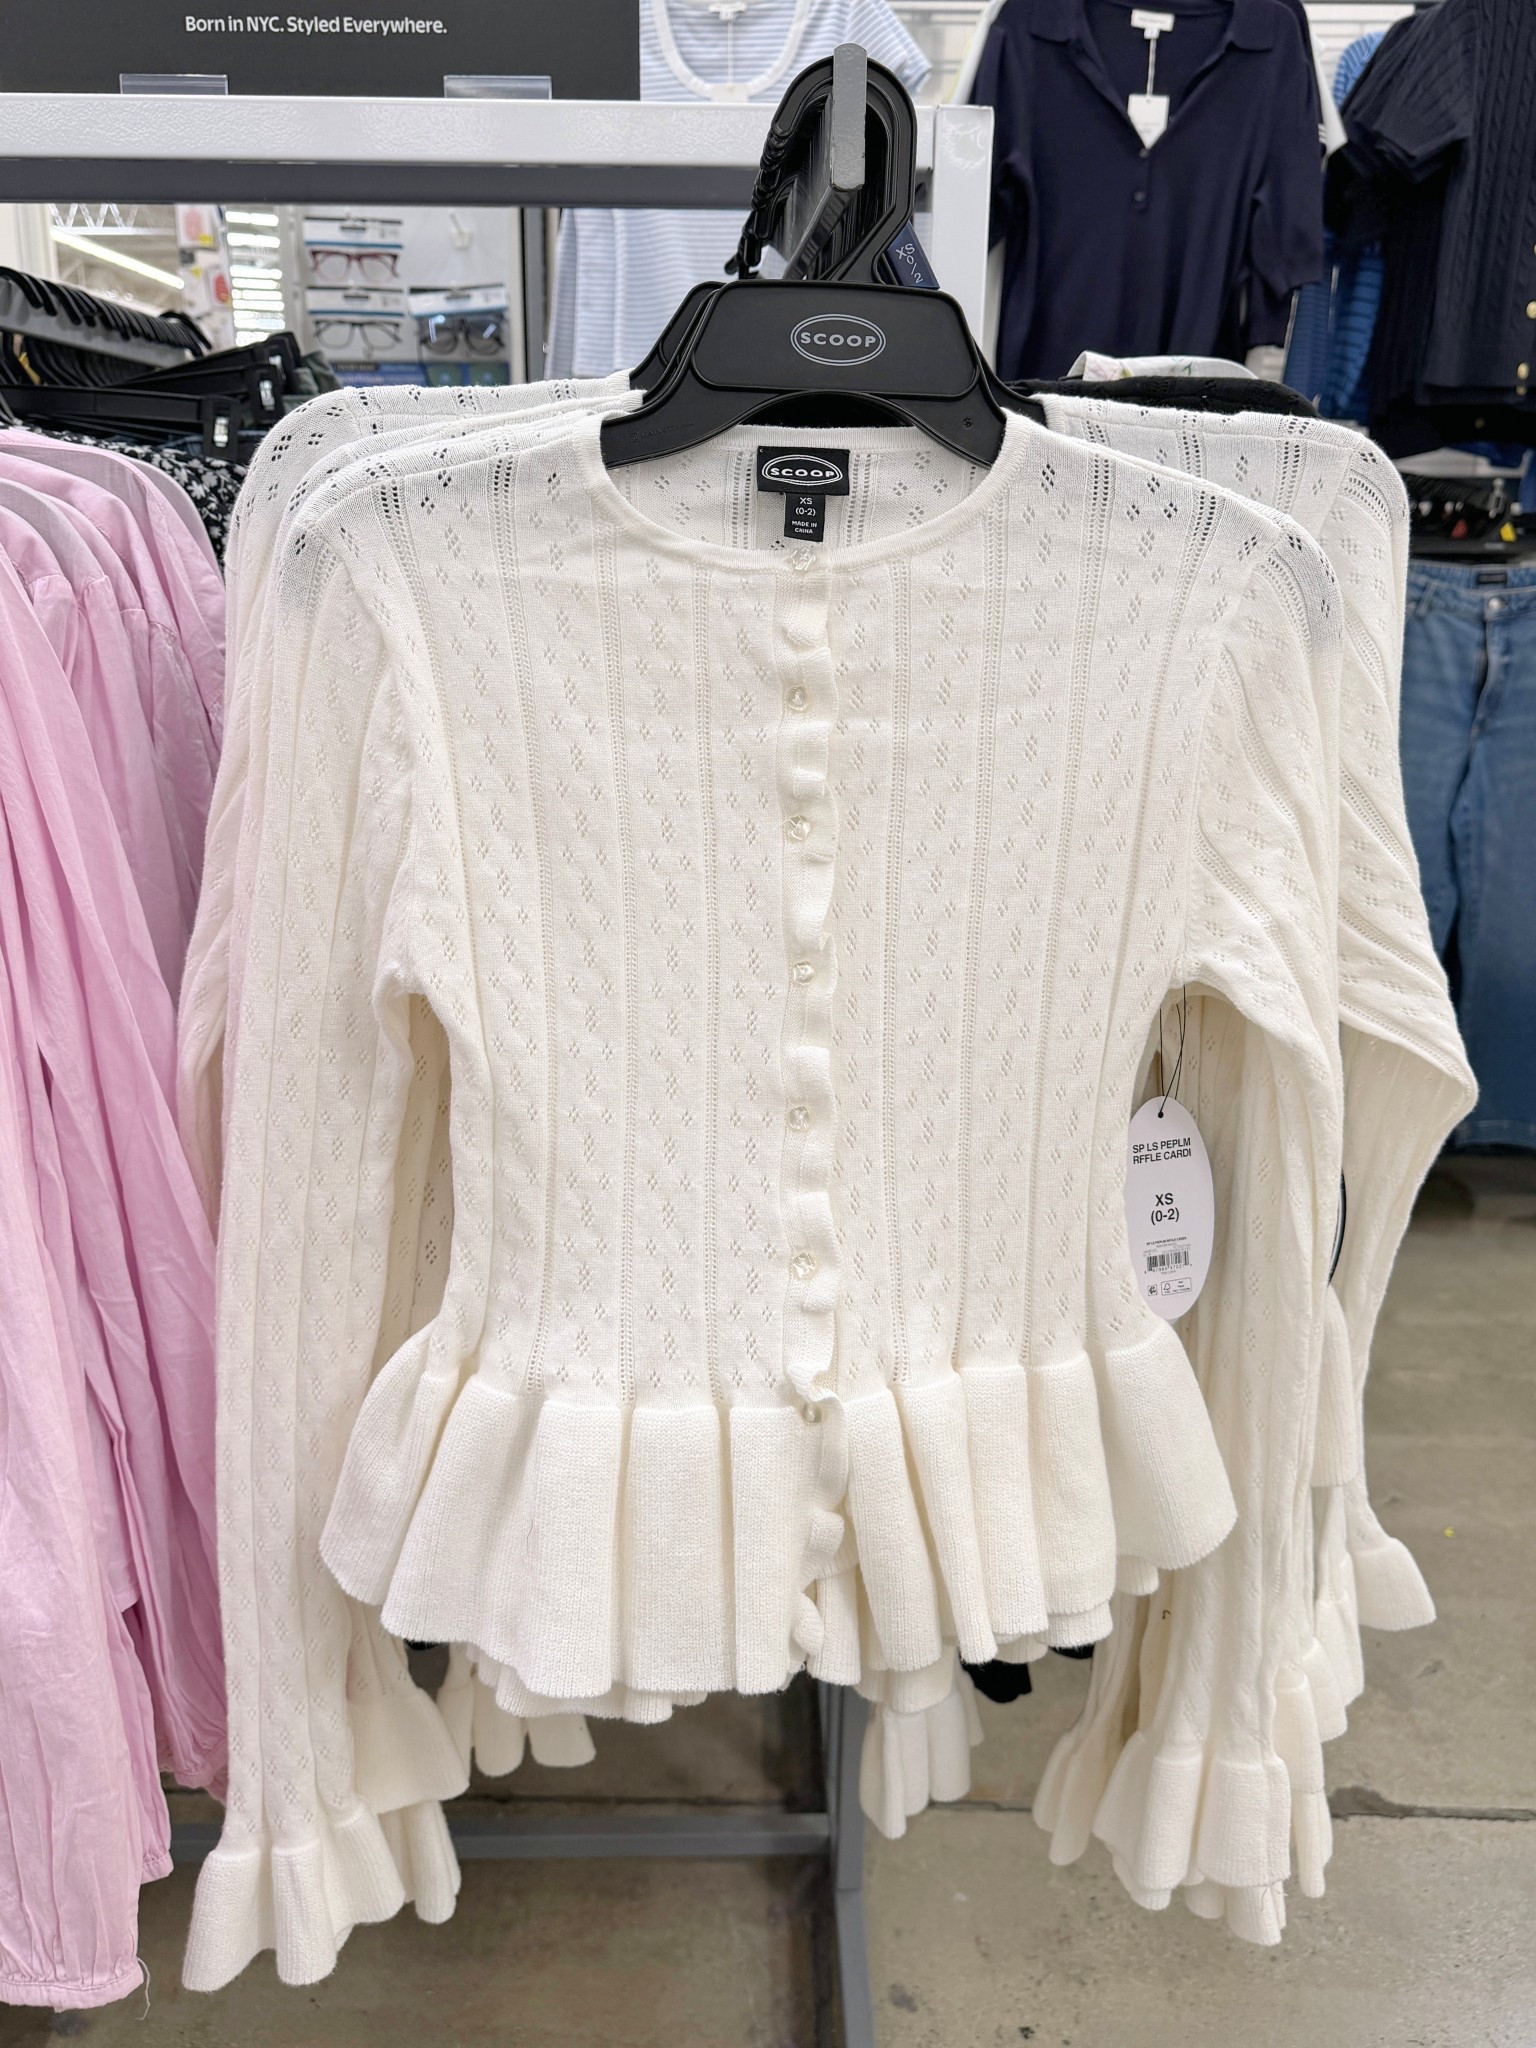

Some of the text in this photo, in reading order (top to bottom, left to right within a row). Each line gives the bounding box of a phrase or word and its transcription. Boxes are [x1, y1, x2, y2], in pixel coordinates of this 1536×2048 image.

[185, 15, 448, 37] Born in NYC. Styled Everywhere.
[895, 243, 915, 260] XS
[800, 332, 876, 347] SCOOP
[770, 467, 835, 478] SCOOP
[799, 497, 813, 505] XS
[795, 507, 816, 516] (0-2)
[1132, 1137, 1191, 1153] SP LS PEPLM
[1132, 1148, 1192, 1165] RFFLE CARDI
[1155, 1192, 1174, 1206] XS
[1150, 1207, 1180, 1225] (0-2)
